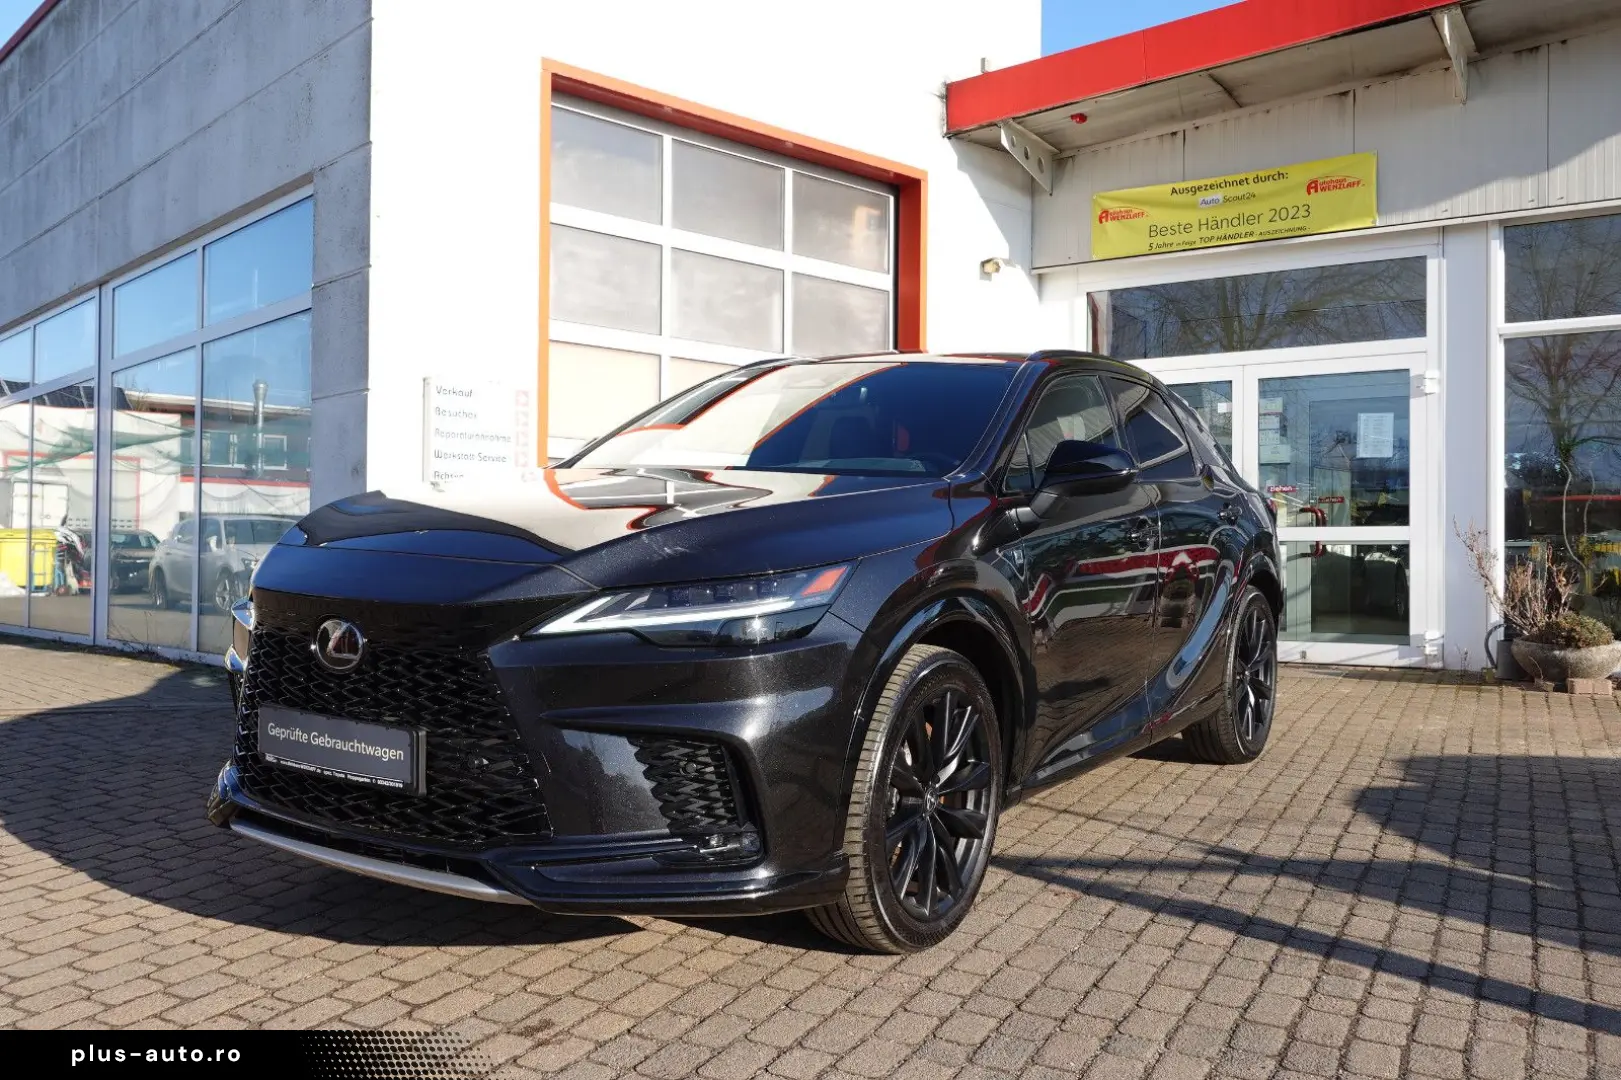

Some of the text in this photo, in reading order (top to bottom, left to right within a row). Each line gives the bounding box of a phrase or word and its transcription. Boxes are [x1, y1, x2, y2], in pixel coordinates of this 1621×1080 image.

[1170, 171, 1289, 197] Ausgezeichnet durch:
[1320, 180, 1361, 192] WENZLAFF
[1200, 191, 1257, 206] Auto Scout24
[1110, 211, 1145, 221] WENZLAFF
[1149, 203, 1311, 238] Beste Händler 2023
[1148, 242, 1154, 251] 5
[1154, 240, 1174, 250] Jahre
[1215, 230, 1255, 243] HÄNDLER
[435, 385, 473, 398] Verkauf
[435, 406, 478, 419] Besucher
[477, 452, 507, 463] Service
[267, 722, 404, 761] Geprüfte Gebrauchtwagen
